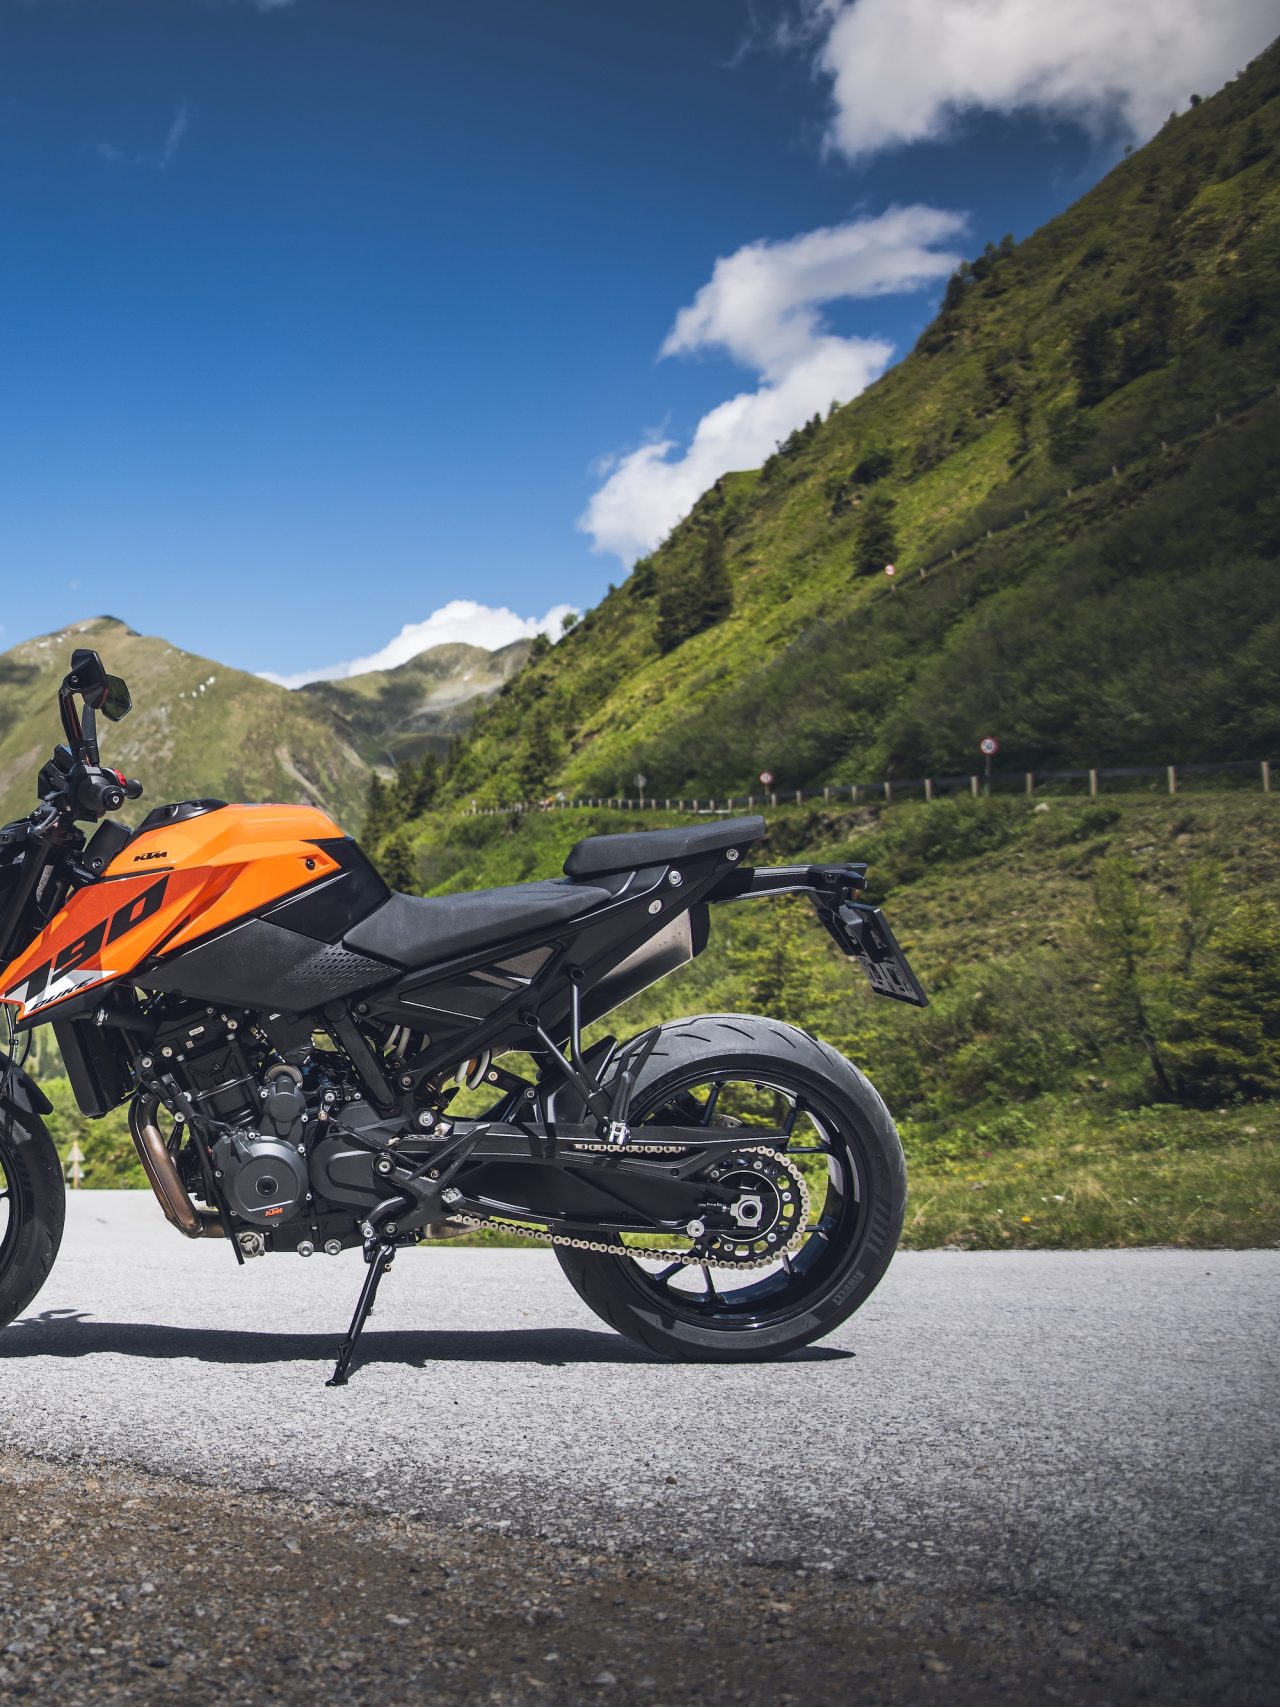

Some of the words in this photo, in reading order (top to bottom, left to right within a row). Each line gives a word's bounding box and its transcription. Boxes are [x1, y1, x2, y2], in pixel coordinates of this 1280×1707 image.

[133, 851, 168, 862] KTM
[4, 873, 170, 1003] 790
[29, 976, 94, 1012] DUKE
[265, 1207, 283, 1217] KTM
